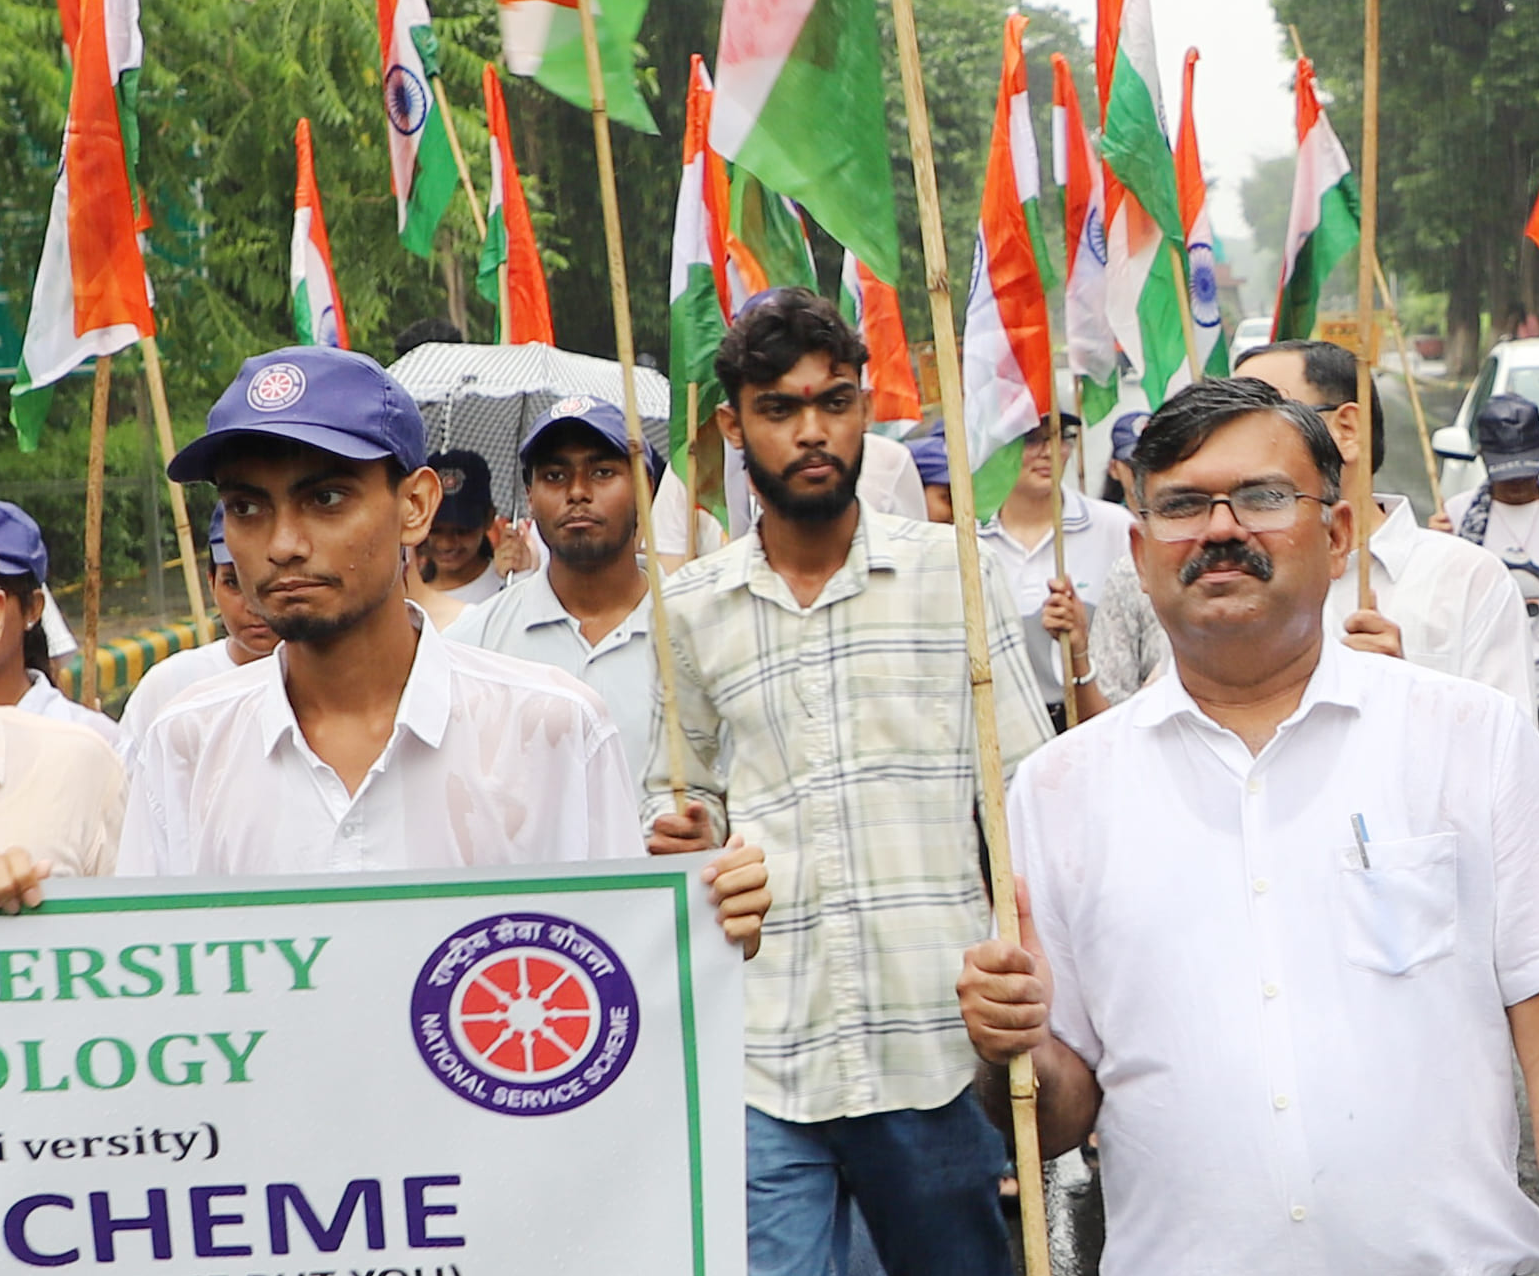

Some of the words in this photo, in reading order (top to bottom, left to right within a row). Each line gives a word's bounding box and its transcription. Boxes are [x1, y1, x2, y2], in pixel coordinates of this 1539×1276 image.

[420, 1013, 488, 1100] NATIONAL
[491, 1076, 589, 1110] SERVICE
[582, 1005, 630, 1086] SCHEME
